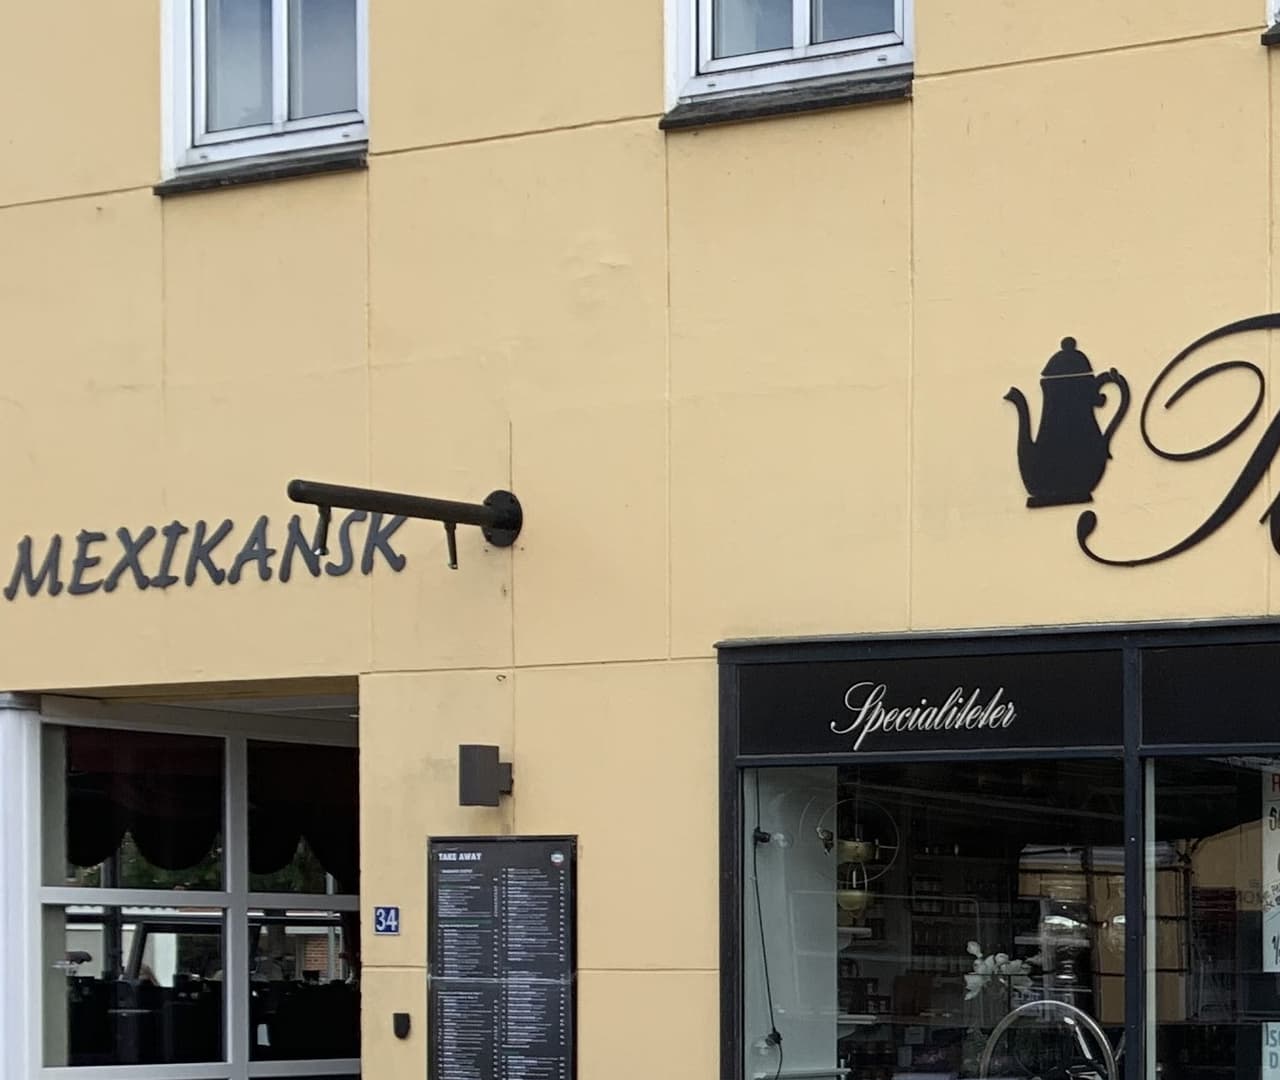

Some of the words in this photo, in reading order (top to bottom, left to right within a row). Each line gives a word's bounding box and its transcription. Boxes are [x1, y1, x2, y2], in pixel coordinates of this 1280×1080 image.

[4, 511, 409, 600] MEXIKANSK
[830, 681, 1017, 751] Specialiteter
[438, 853, 457, 861] TAKE
[459, 853, 482, 861] AWAY
[376, 908, 399, 932] 34
